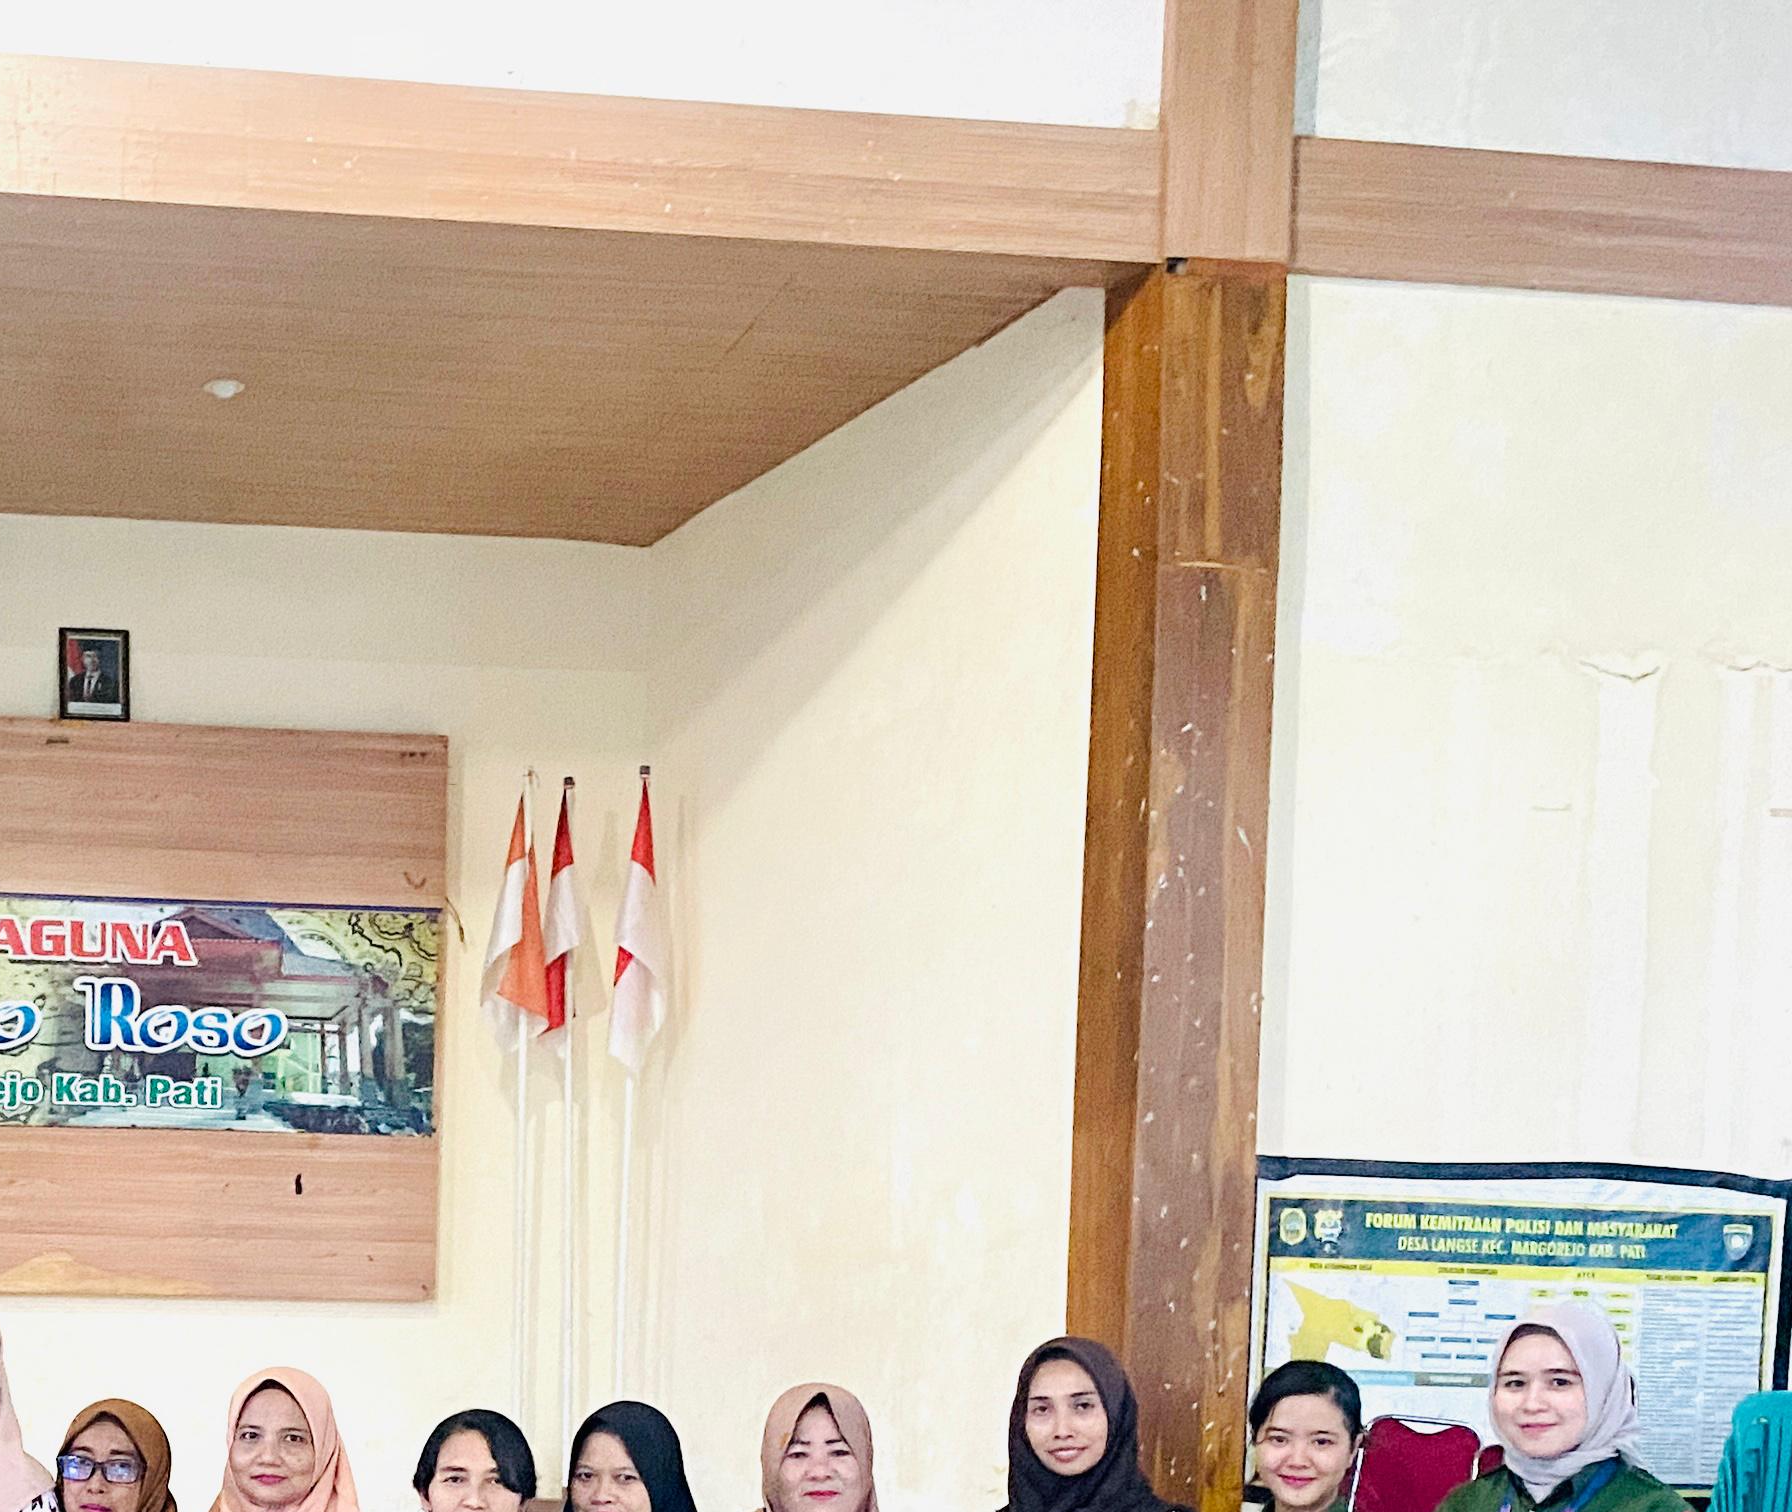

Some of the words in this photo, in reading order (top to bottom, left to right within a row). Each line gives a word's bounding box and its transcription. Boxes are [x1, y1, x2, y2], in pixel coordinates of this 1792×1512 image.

[76, 978, 285, 1053] Roso
[55, 1076, 134, 1105] Kab.
[149, 1077, 220, 1108] Pati
[1365, 1212, 1416, 1230] FORUM
[1420, 1214, 1501, 1233] KEMITRAAN
[1505, 1217, 1551, 1235] POLISI
[1555, 1220, 1584, 1236] DAN
[1397, 1236, 1429, 1251] DESA
[1431, 1237, 1479, 1253] LANGSE
[1511, 1240, 1586, 1257] MARGOREJO
[1620, 1244, 1647, 1259] PATI
